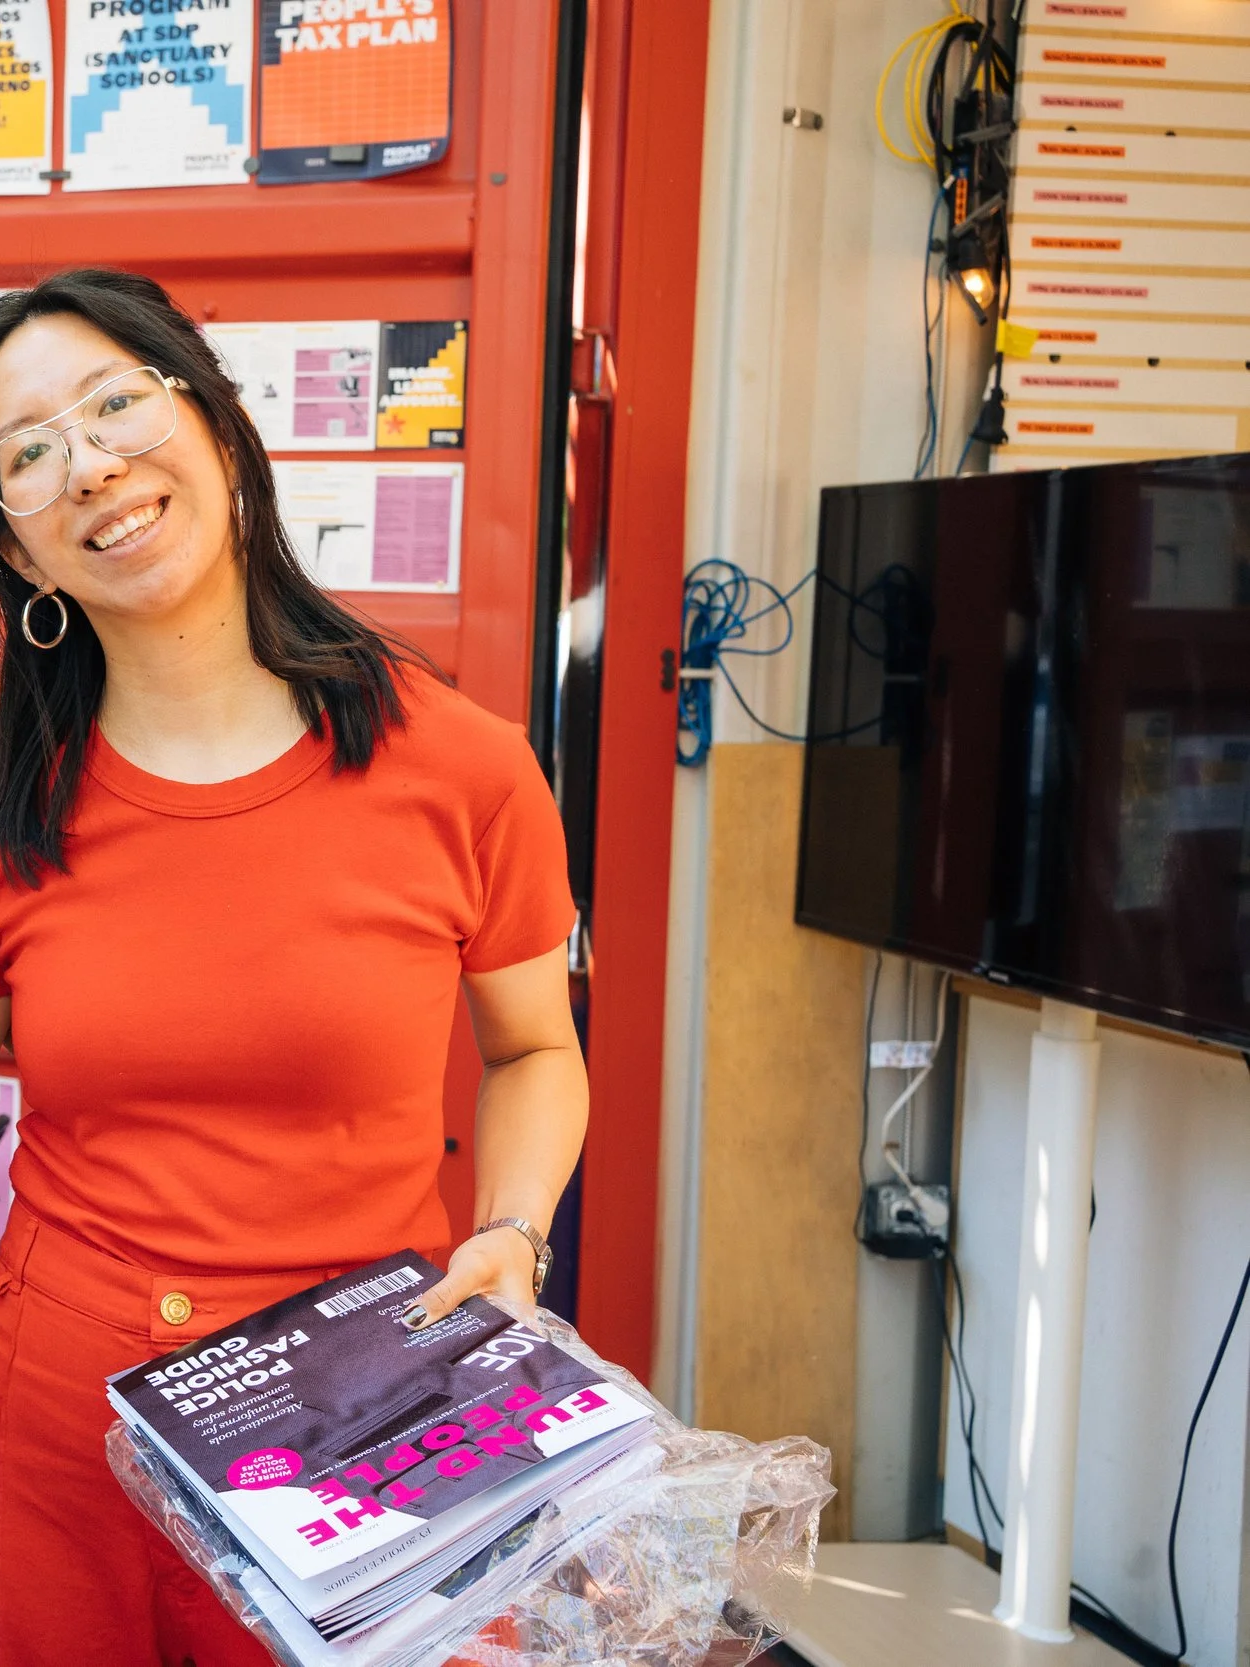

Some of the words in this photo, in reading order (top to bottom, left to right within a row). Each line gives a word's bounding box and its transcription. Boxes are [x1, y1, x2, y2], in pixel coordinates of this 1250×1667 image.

[119, 28, 148, 43] AT
[154, 24, 199, 41] SDP
[274, 24, 343, 53] TAX
[347, 17, 438, 48] PLAN
[85, 42, 233, 67] (SANCTUARY
[101, 67, 215, 90] SCHOOLS)
[441, 1313, 475, 1331] Whose
[450, 1308, 466, 1319] Are
[419, 1316, 481, 1347] Departments
[430, 1318, 451, 1328] Less
[460, 1325, 479, 1337] City
[402, 1328, 442, 1347] Budgets
[406, 1327, 431, 1338] Than
[143, 1337, 247, 1387] GUIDE
[158, 1328, 310, 1401] FASHION
[172, 1358, 293, 1416] POLICE
[472, 1383, 503, 1402] FASHION
[228, 1382, 289, 1412] community
[270, 1392, 293, 1408] and
[456, 1399, 473, 1409] AND
[192, 1409, 224, 1426] safety
[218, 1405, 269, 1428] uniforms
[237, 1399, 301, 1432] Alternative
[425, 1407, 458, 1425] LIFESTYLE
[200, 1423, 217, 1435] for
[208, 1431, 237, 1444] tools
[389, 1421, 427, 1442] MAGAZINE
[437, 1387, 608, 1478] FUND
[308, 1383, 544, 1507] PEOPLE
[375, 1439, 391, 1449] FOR
[240, 1457, 285, 1471] DOLLARS
[333, 1445, 376, 1469] COMMUNITY
[239, 1470, 259, 1478] TAX
[256, 1468, 291, 1482] WHERE
[260, 1463, 289, 1473] YOUR
[308, 1466, 333, 1480] SAFETY
[238, 1476, 255, 1484] DO
[296, 1480, 426, 1547] THE
[404, 1535, 417, 1547] 26
[417, 1526, 431, 1539] FY
[367, 1542, 406, 1569] POLICE
[322, 1565, 368, 1595] FASHION
